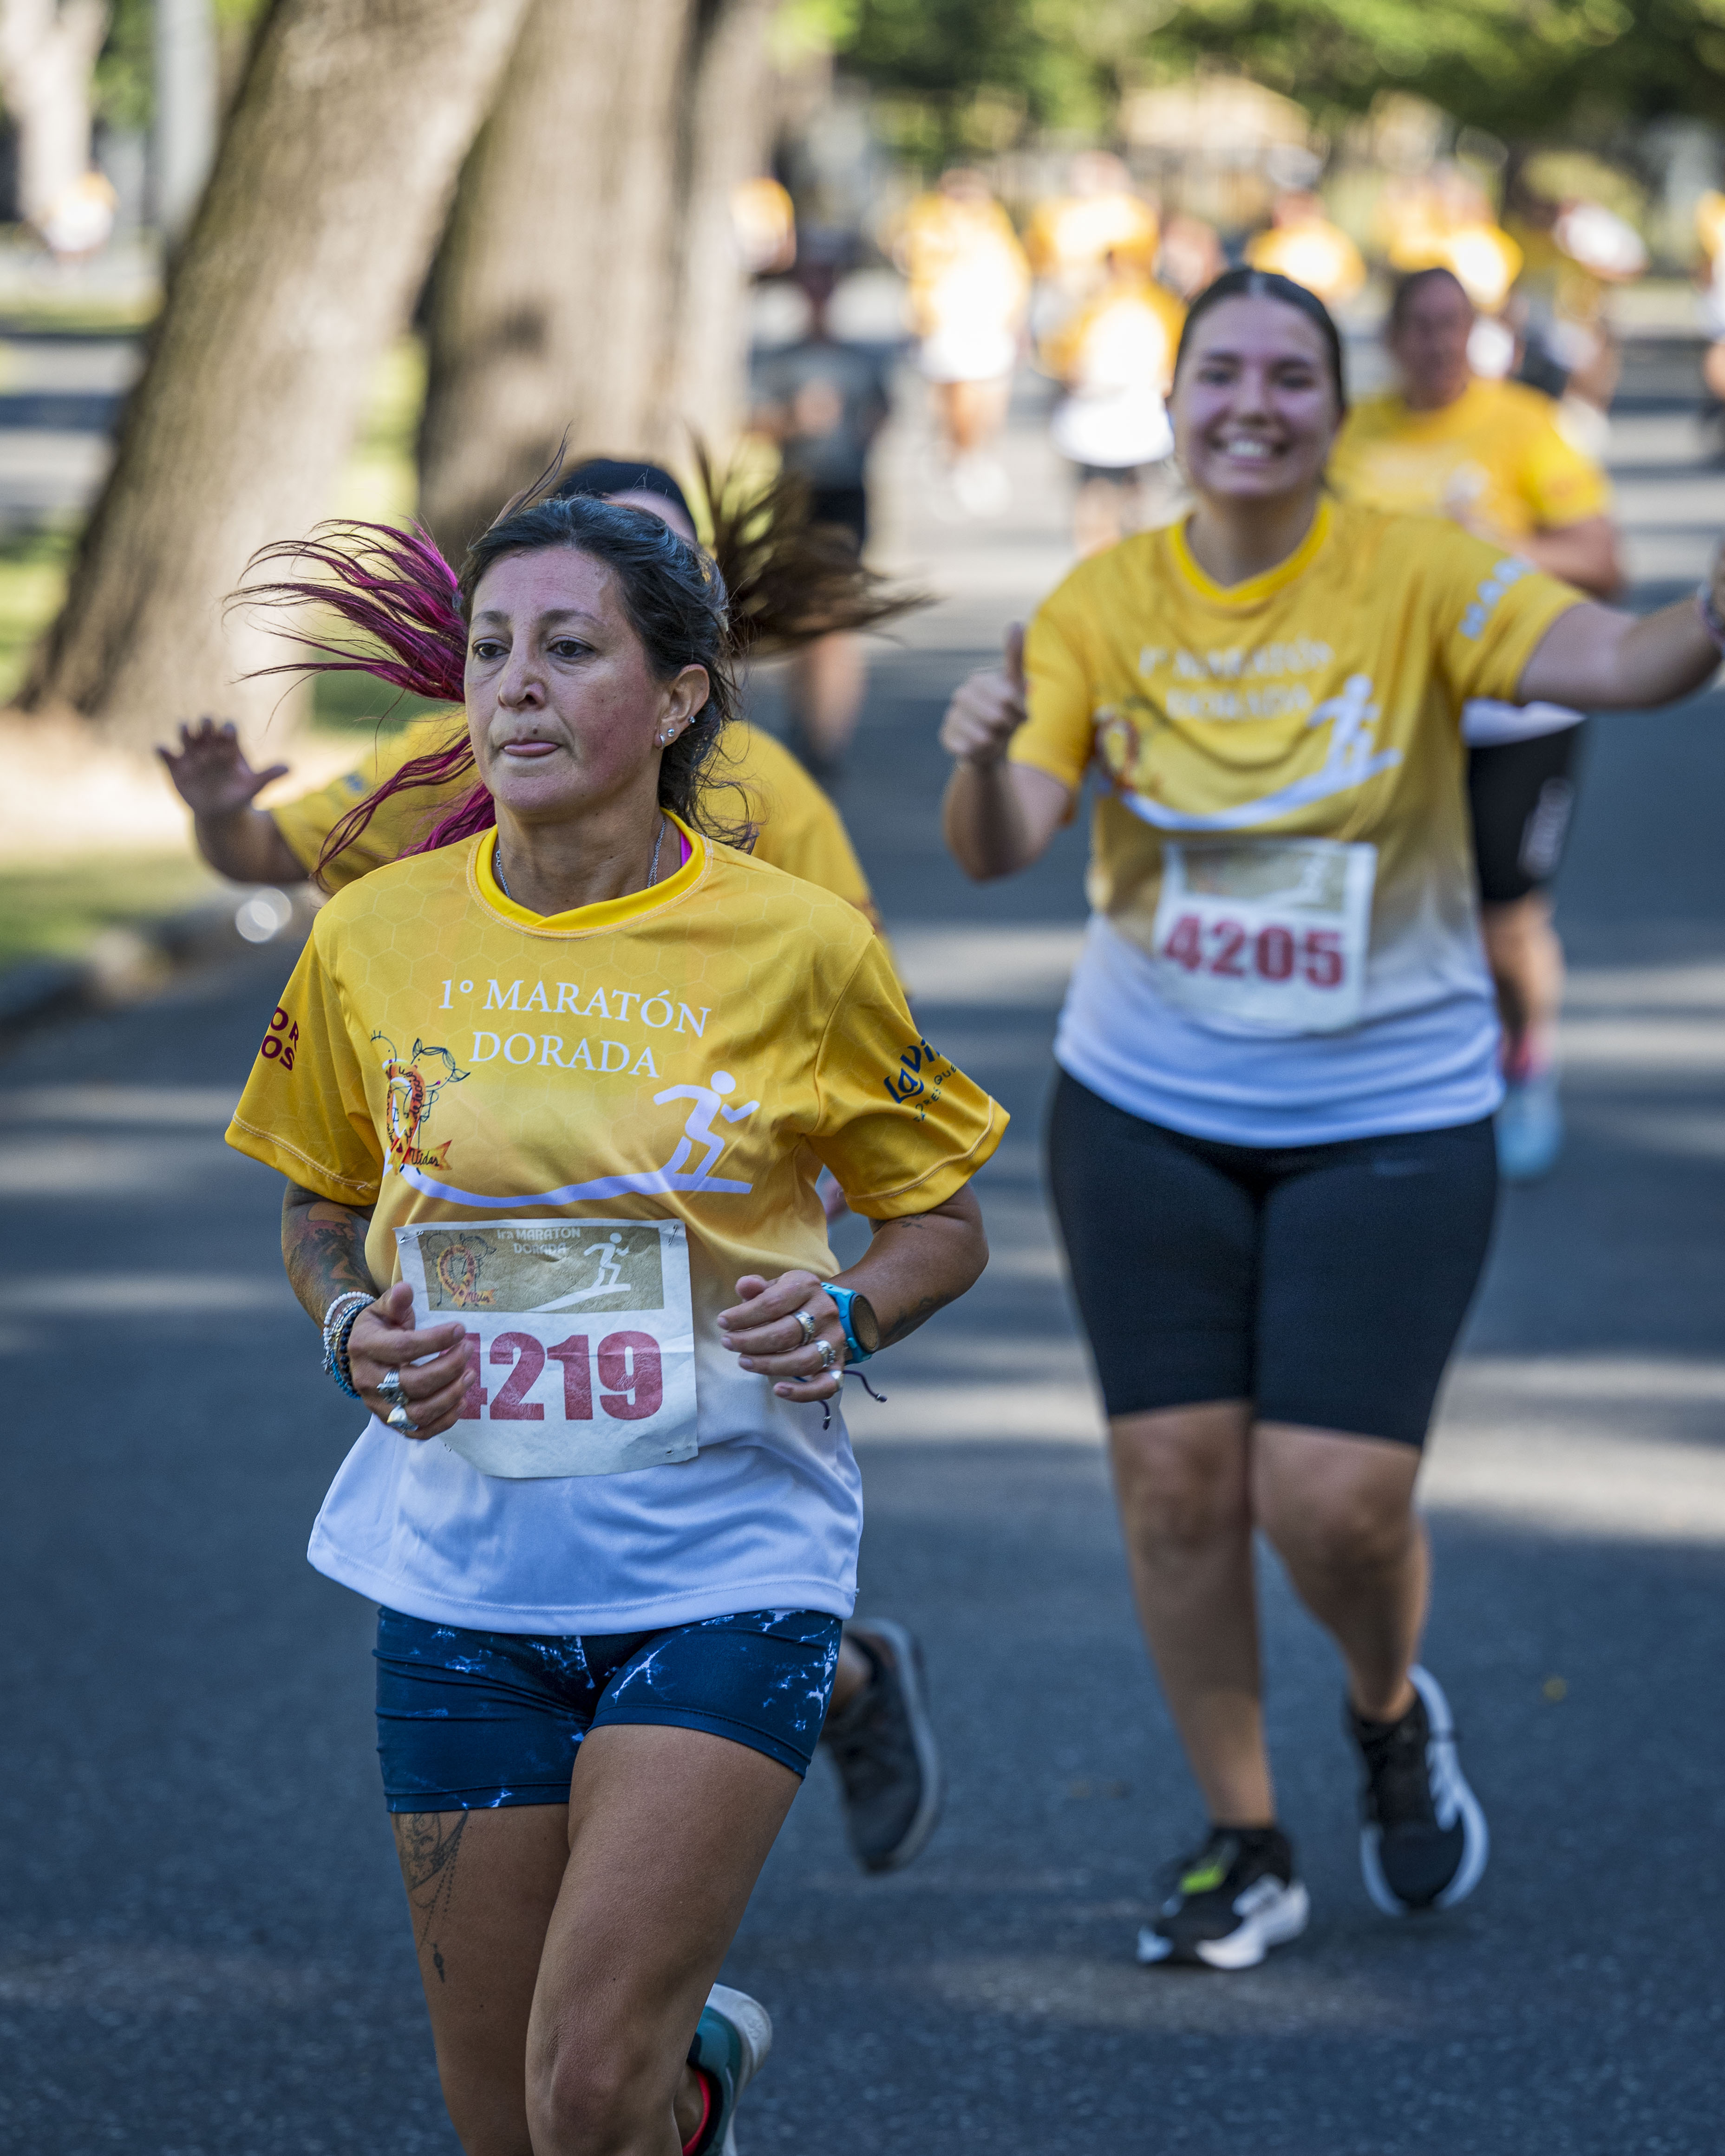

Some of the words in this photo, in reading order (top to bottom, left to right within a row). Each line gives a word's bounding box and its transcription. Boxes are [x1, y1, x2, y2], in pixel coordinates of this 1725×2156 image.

[1164, 915, 1343, 989] 4205
[482, 979, 712, 1038] MARATÓN
[469, 1031, 660, 1078] DORADA
